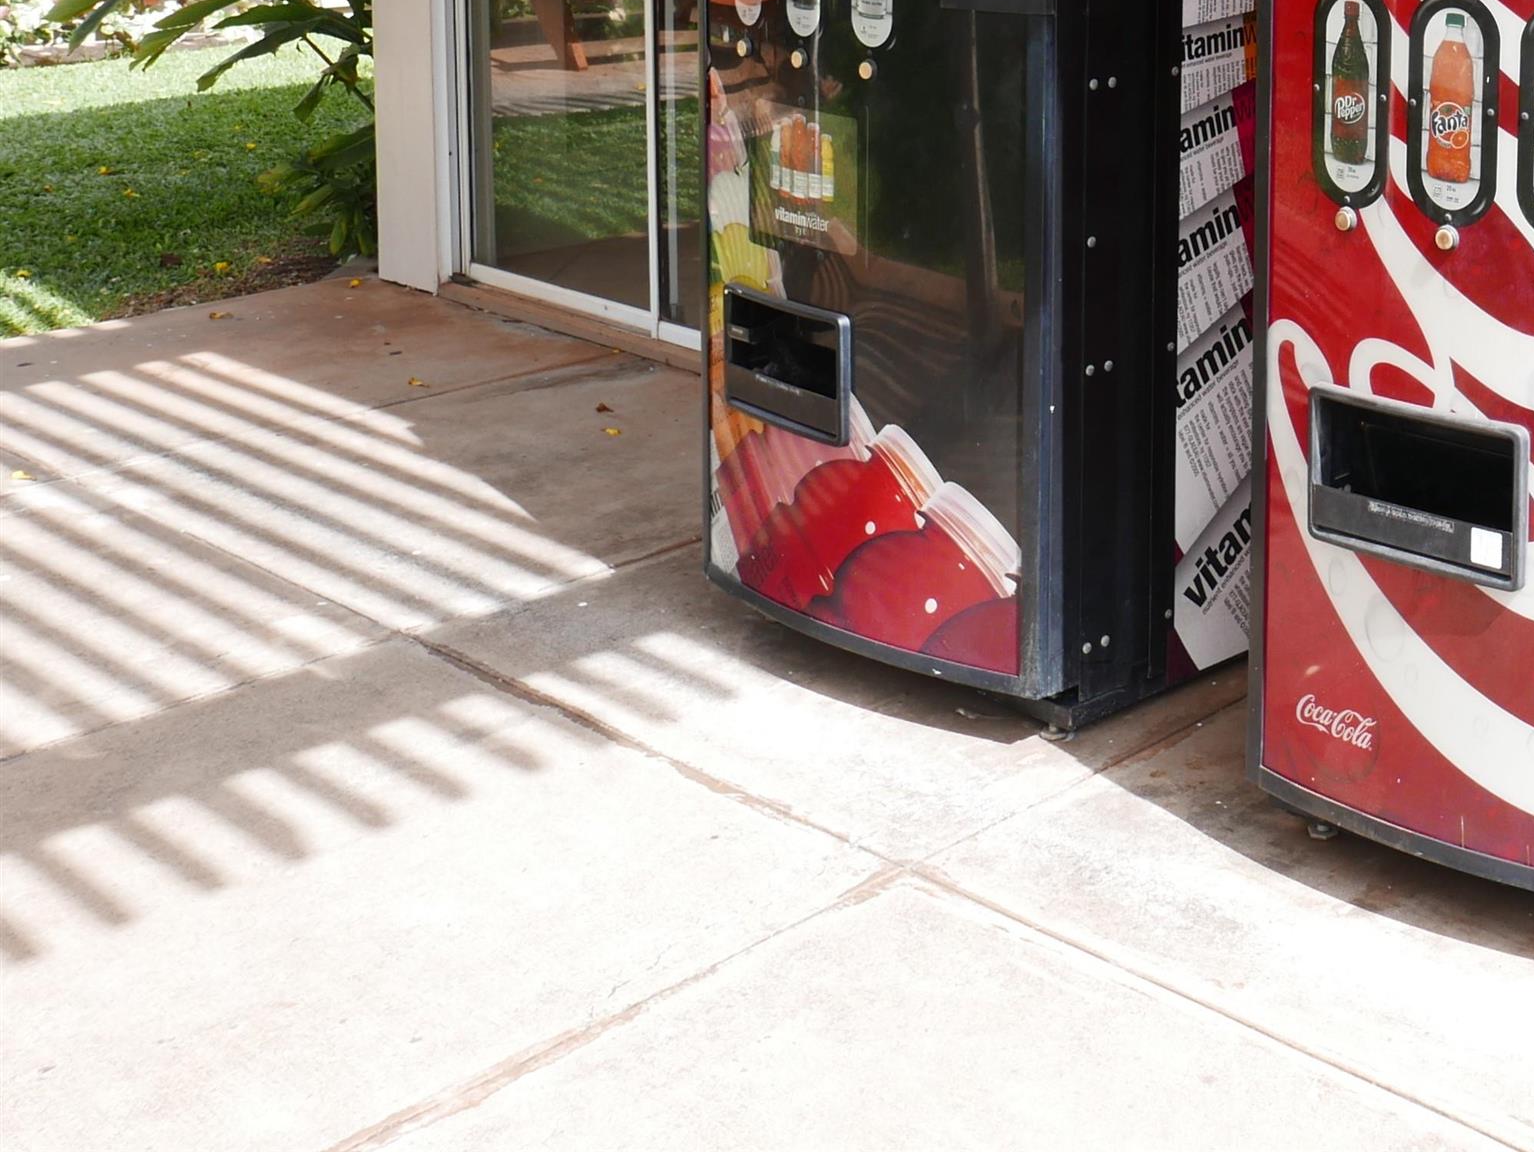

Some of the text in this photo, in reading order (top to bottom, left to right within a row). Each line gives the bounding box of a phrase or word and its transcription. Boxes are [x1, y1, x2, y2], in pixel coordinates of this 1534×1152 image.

[1337, 97, 1364, 120] Pepper
[1345, 95, 1357, 107] Dr
[1431, 110, 1469, 138] Fanta
[1296, 694, 1377, 750] Coca-Cola
